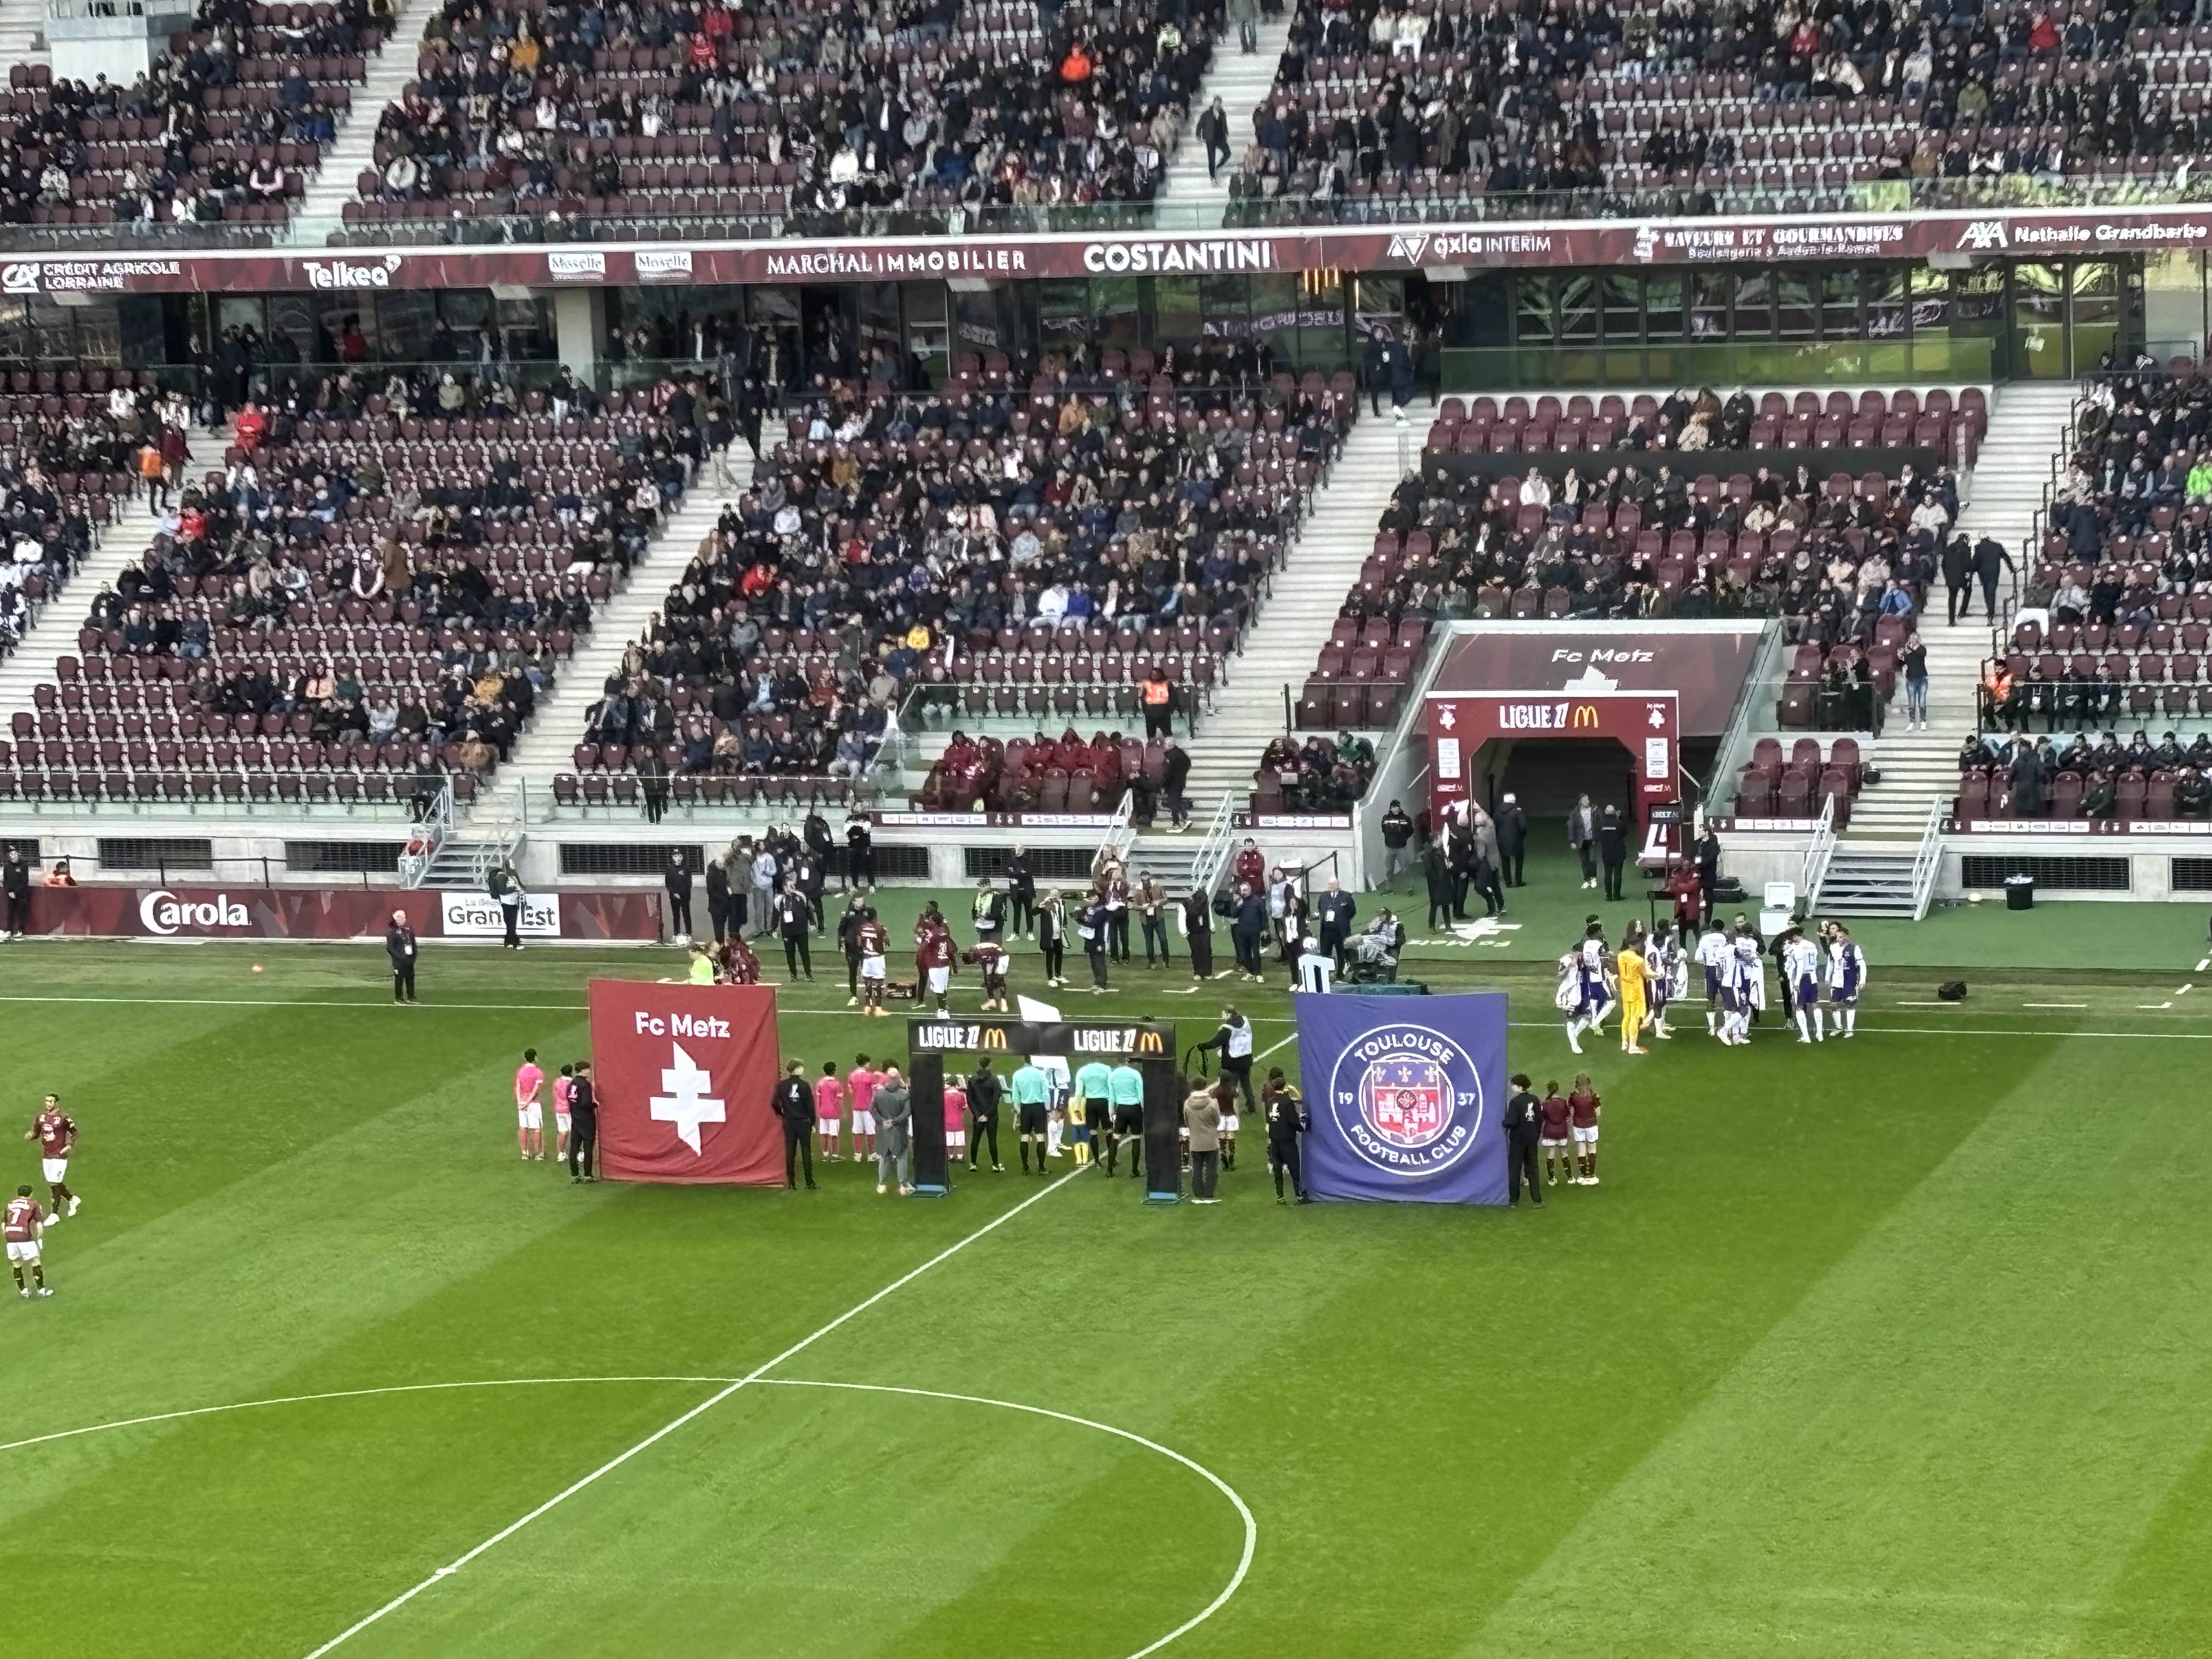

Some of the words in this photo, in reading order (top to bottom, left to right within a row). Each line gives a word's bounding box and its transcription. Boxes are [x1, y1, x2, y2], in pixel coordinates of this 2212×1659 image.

[1956, 222, 2009, 249] AXA
[2015, 225, 2091, 242] Nathalie
[767, 252, 872, 274] MARCHAL
[878, 250, 1026, 272] IMMOBILIER
[1084, 240, 1271, 272] COSTANTINI
[303, 262, 388, 289] Telkea
[1590, 649, 1655, 663] Metz
[1499, 705, 1552, 729] LIGUE
[140, 891, 249, 934] Carola
[448, 906, 502, 925] Gran
[521, 905, 556, 926] Est
[671, 1013, 731, 1038] Metz
[919, 1026, 965, 1048] LIGUE
[1074, 1030, 1122, 1052] LIGUE
[1354, 1033, 1454, 1064] TOULOUSE
[1338, 1092, 1354, 1105] 19
[1458, 1093, 1476, 1106] 37
[1351, 1124, 1431, 1165] FOOTBALL
[1431, 1125, 1467, 1159] CLUB
